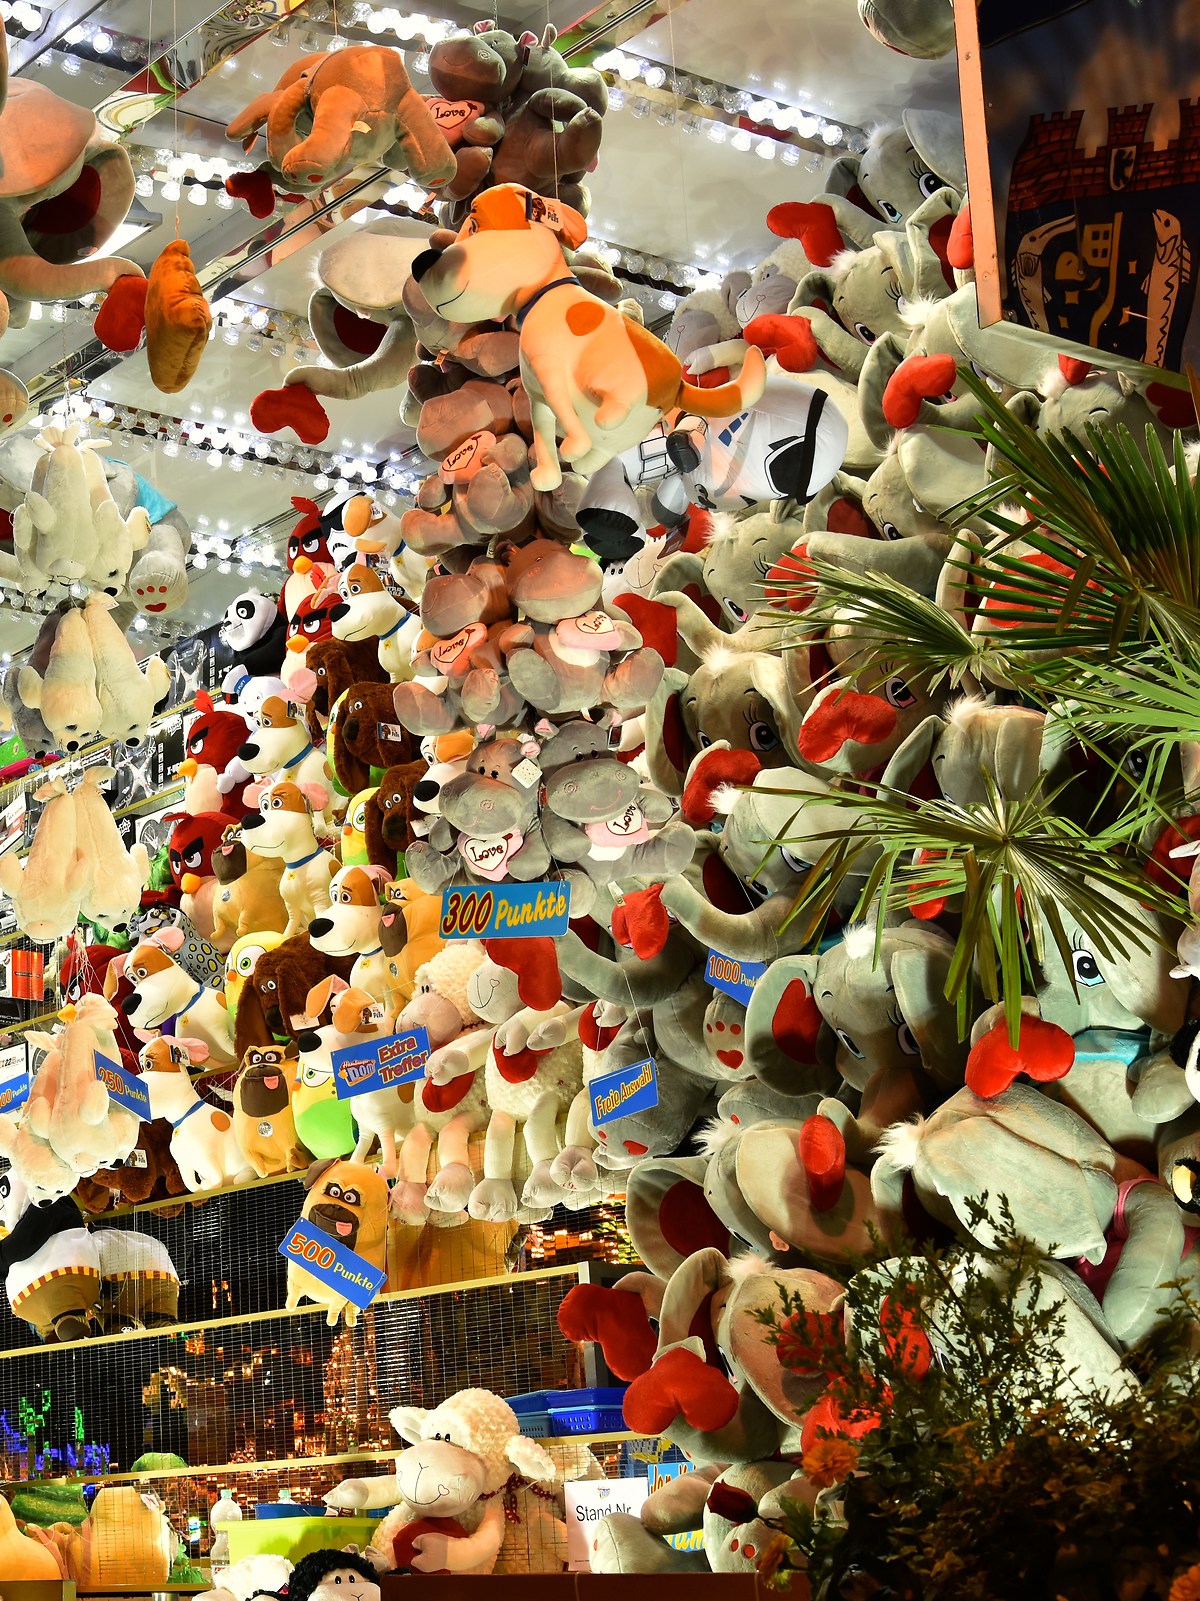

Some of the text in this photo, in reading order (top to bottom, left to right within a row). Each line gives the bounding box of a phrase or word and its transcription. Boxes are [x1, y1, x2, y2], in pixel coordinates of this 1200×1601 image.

[435, 107, 466, 119] Love
[447, 444, 474, 468] Love
[438, 638, 465, 658] Love
[612, 804, 637, 833] Love
[470, 844, 504, 862] Love
[441, 890, 567, 935] 300 Punkte
[709, 954, 758, 988] 1000 Punk
[378, 1036, 418, 1065] Extra
[378, 1050, 428, 1084] Treffer
[98, 1066, 147, 1103] 250 Punkte
[594, 1062, 653, 1119] Freie Auswahl
[287, 1232, 374, 1291] 500 Punkte
[576, 1504, 611, 1522] Stand
